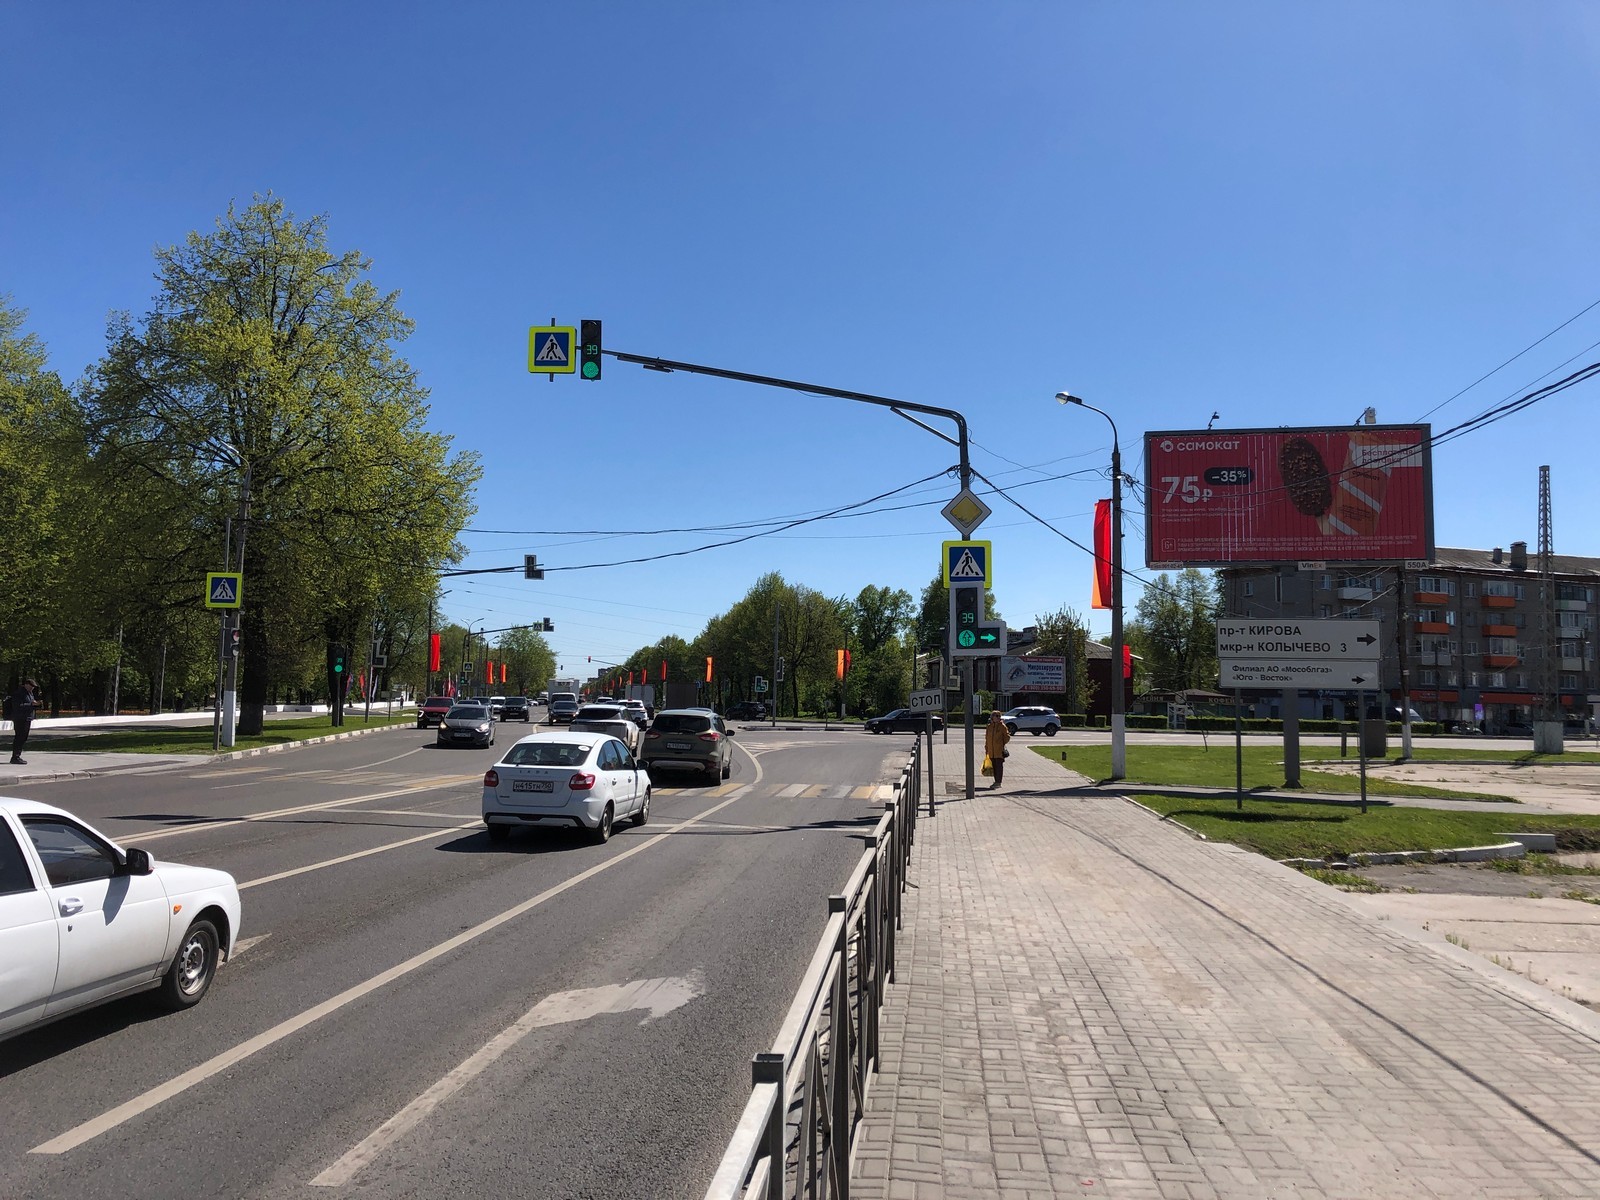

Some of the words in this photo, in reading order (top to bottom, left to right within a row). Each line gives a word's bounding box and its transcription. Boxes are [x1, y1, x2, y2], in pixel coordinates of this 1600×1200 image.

[586, 344, 598, 355] 39
[1176, 440, 1240, 451] самокат
[962, 612, 974, 624] 39
[1219, 626, 1246, 637] пр-т
[1248, 625, 1302, 636] КИРОВА
[1219, 643, 1254, 653] мкр-н
[1257, 642, 1331, 653] КОЛЫЧЕВО
[1340, 643, 1347, 653] 3
[1232, 664, 1265, 673] Филиал
[1266, 665, 1279, 673] АО
[911, 694, 941, 708] СТОП
